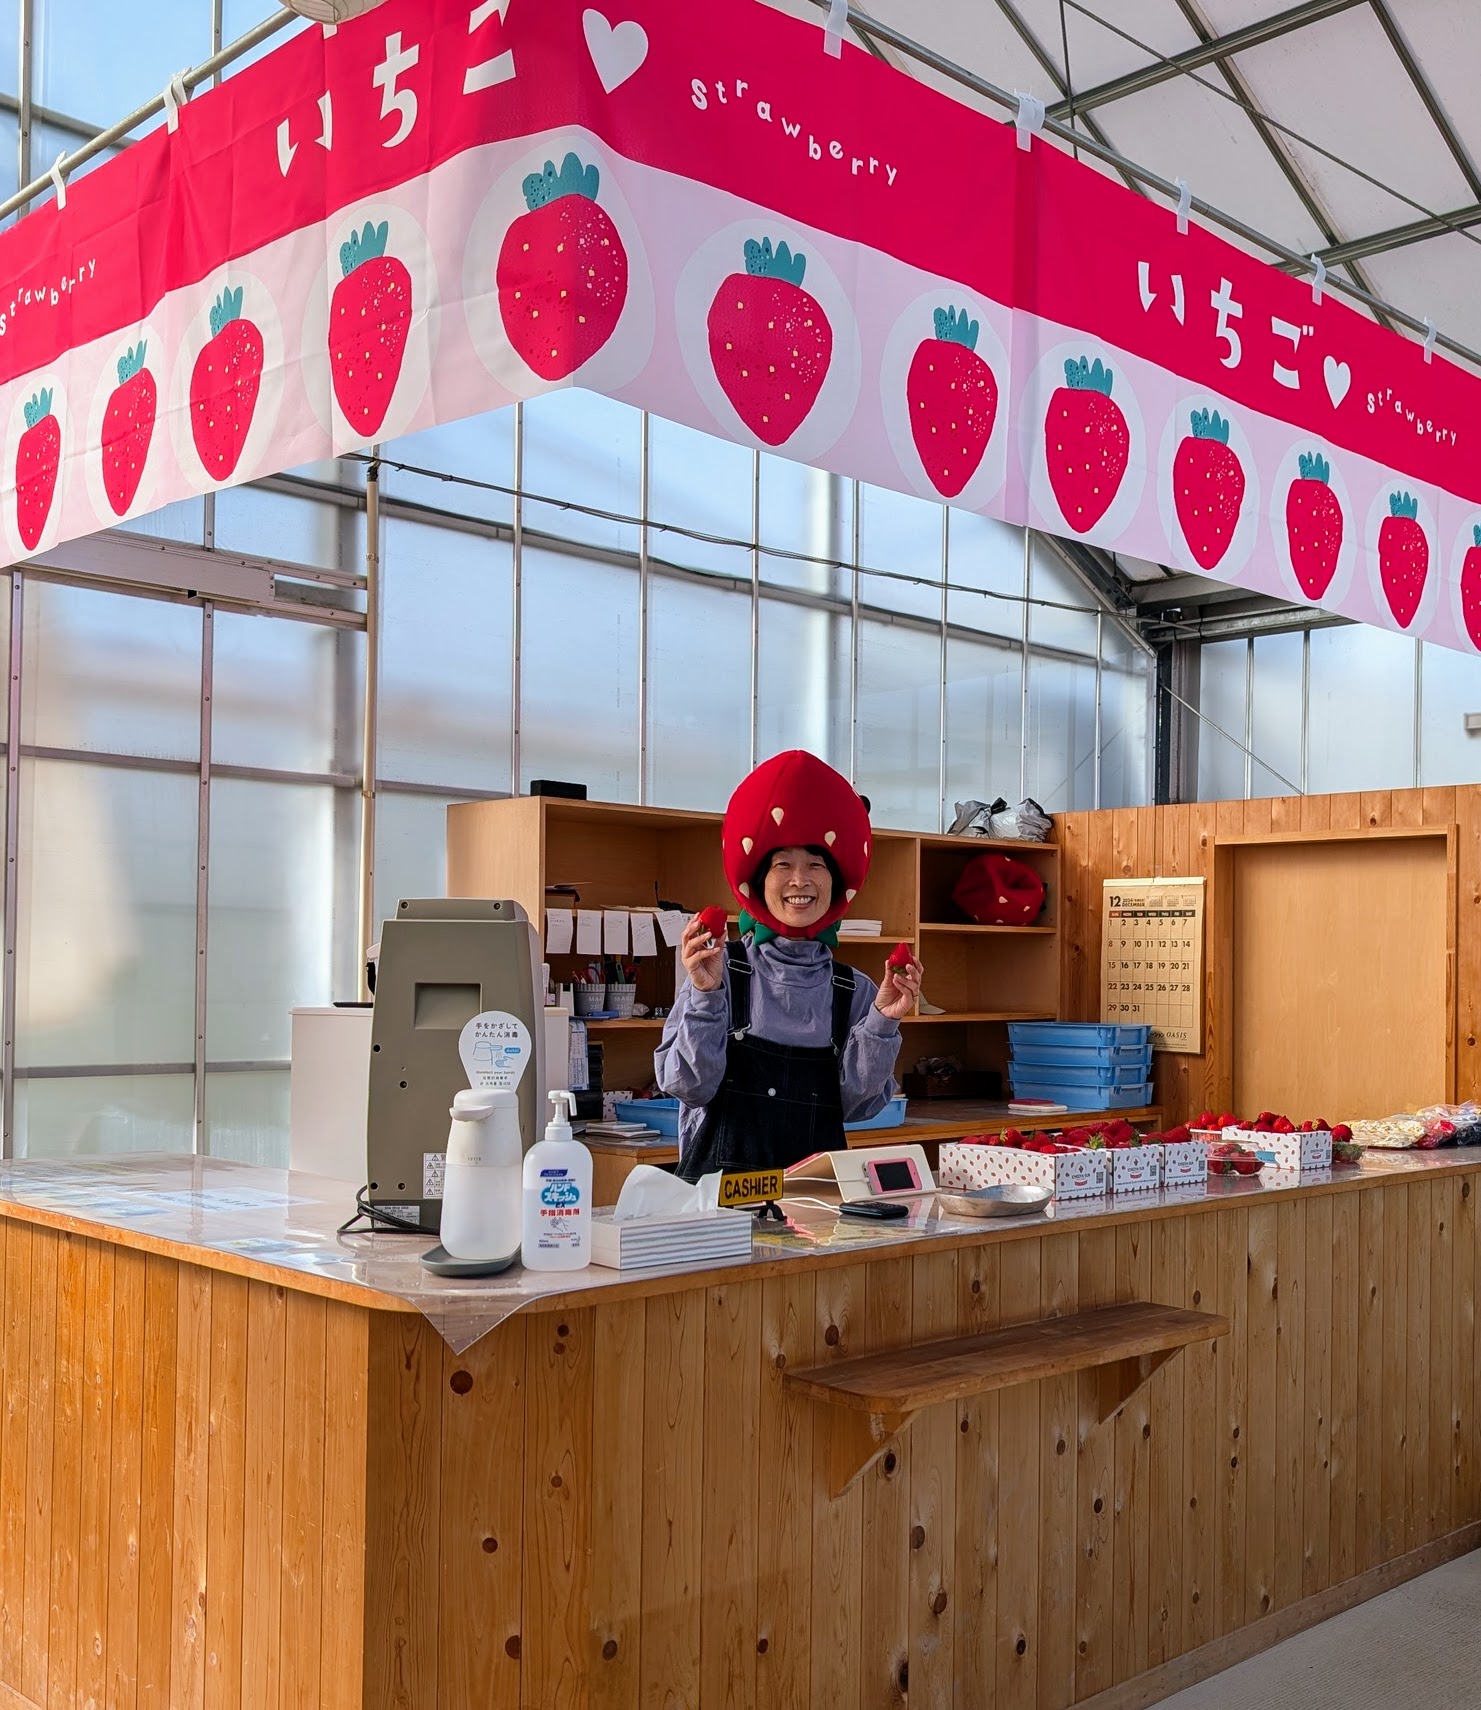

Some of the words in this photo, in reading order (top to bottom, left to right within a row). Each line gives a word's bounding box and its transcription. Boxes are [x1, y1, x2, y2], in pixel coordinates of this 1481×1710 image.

[1137, 260, 1315, 390] いちご
[1109, 895, 1121, 908] 12
[475, 1022, 518, 1030] 手をかざして
[724, 1175, 778, 1199] CASHIER
[540, 1208, 580, 1217] 手指消毒剤
